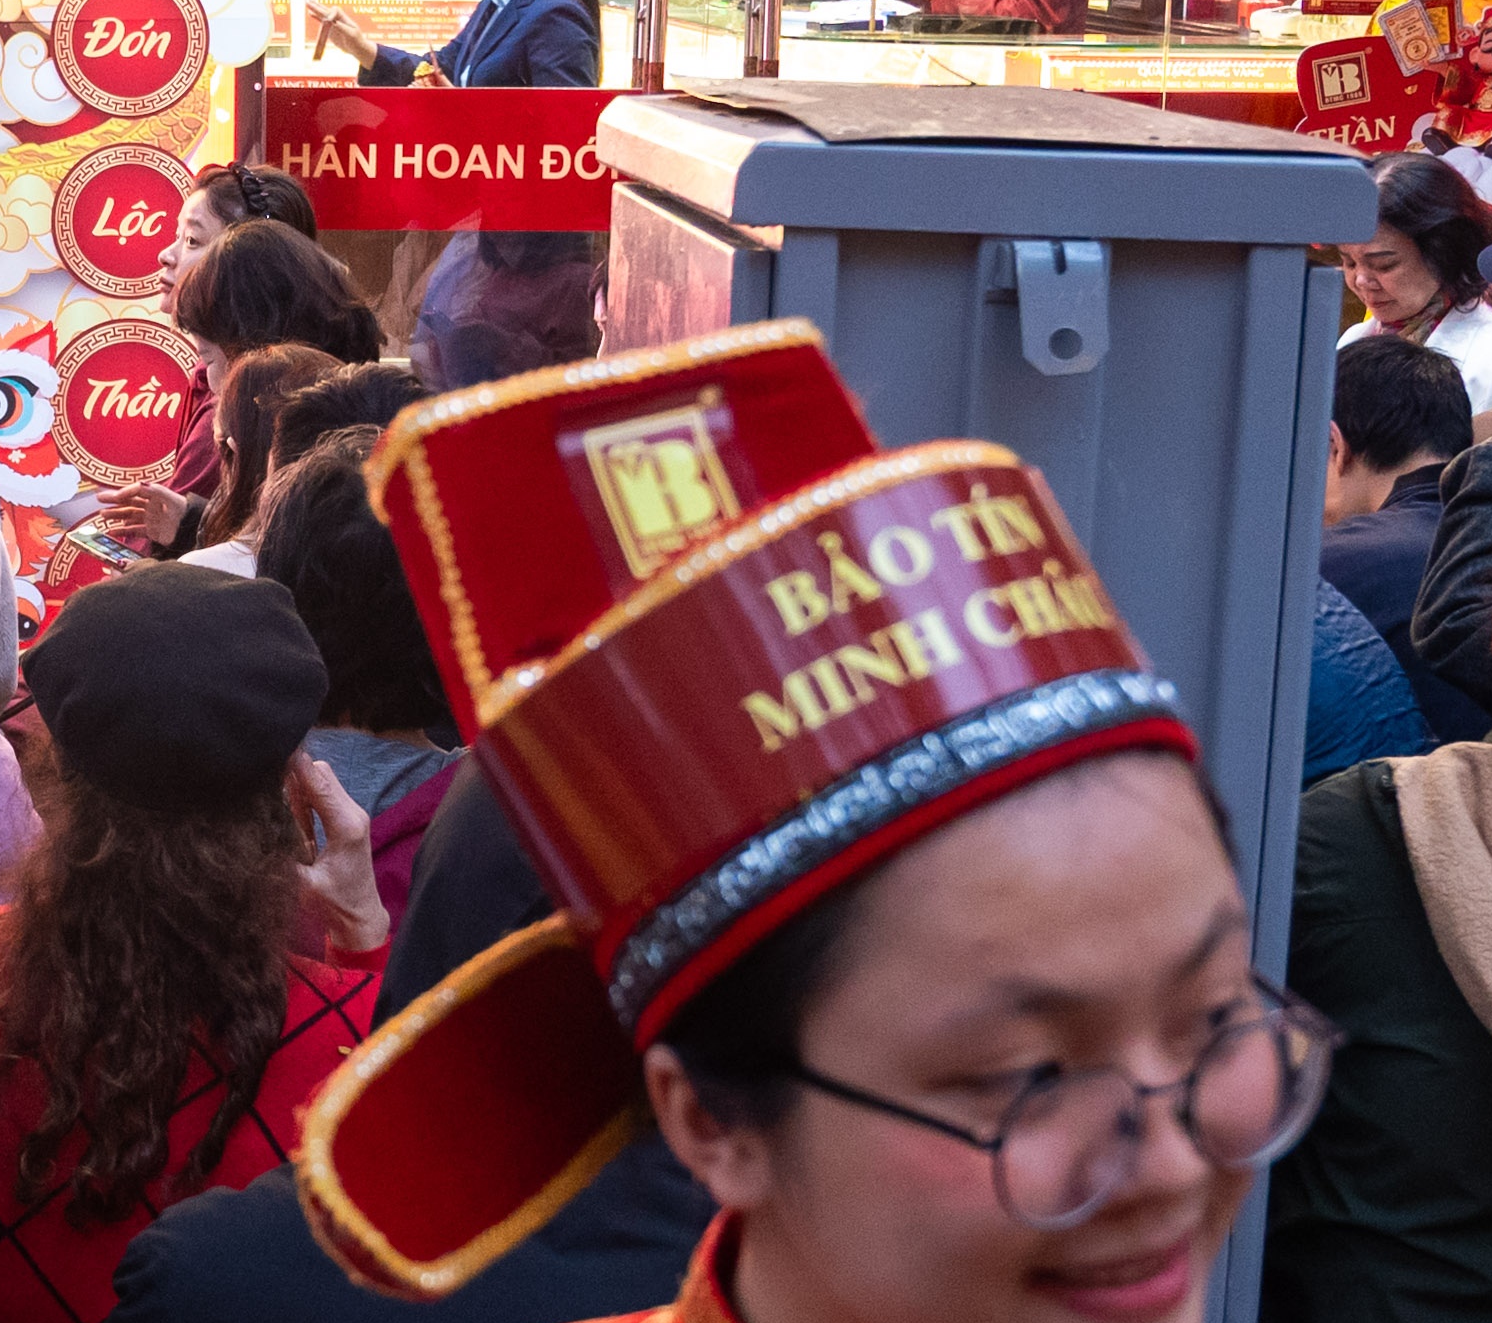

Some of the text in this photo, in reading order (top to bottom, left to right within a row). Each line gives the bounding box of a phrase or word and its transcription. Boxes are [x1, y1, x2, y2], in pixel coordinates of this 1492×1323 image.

[83, 15, 173, 62] Đón
[282, 126, 619, 183] HÂN HOAN ĐÓ
[1307, 115, 1396, 146] THẦN
[91, 199, 164, 246] Lộc
[81, 372, 183, 424] Thần
[766, 482, 1048, 638] BẢO TÍN
